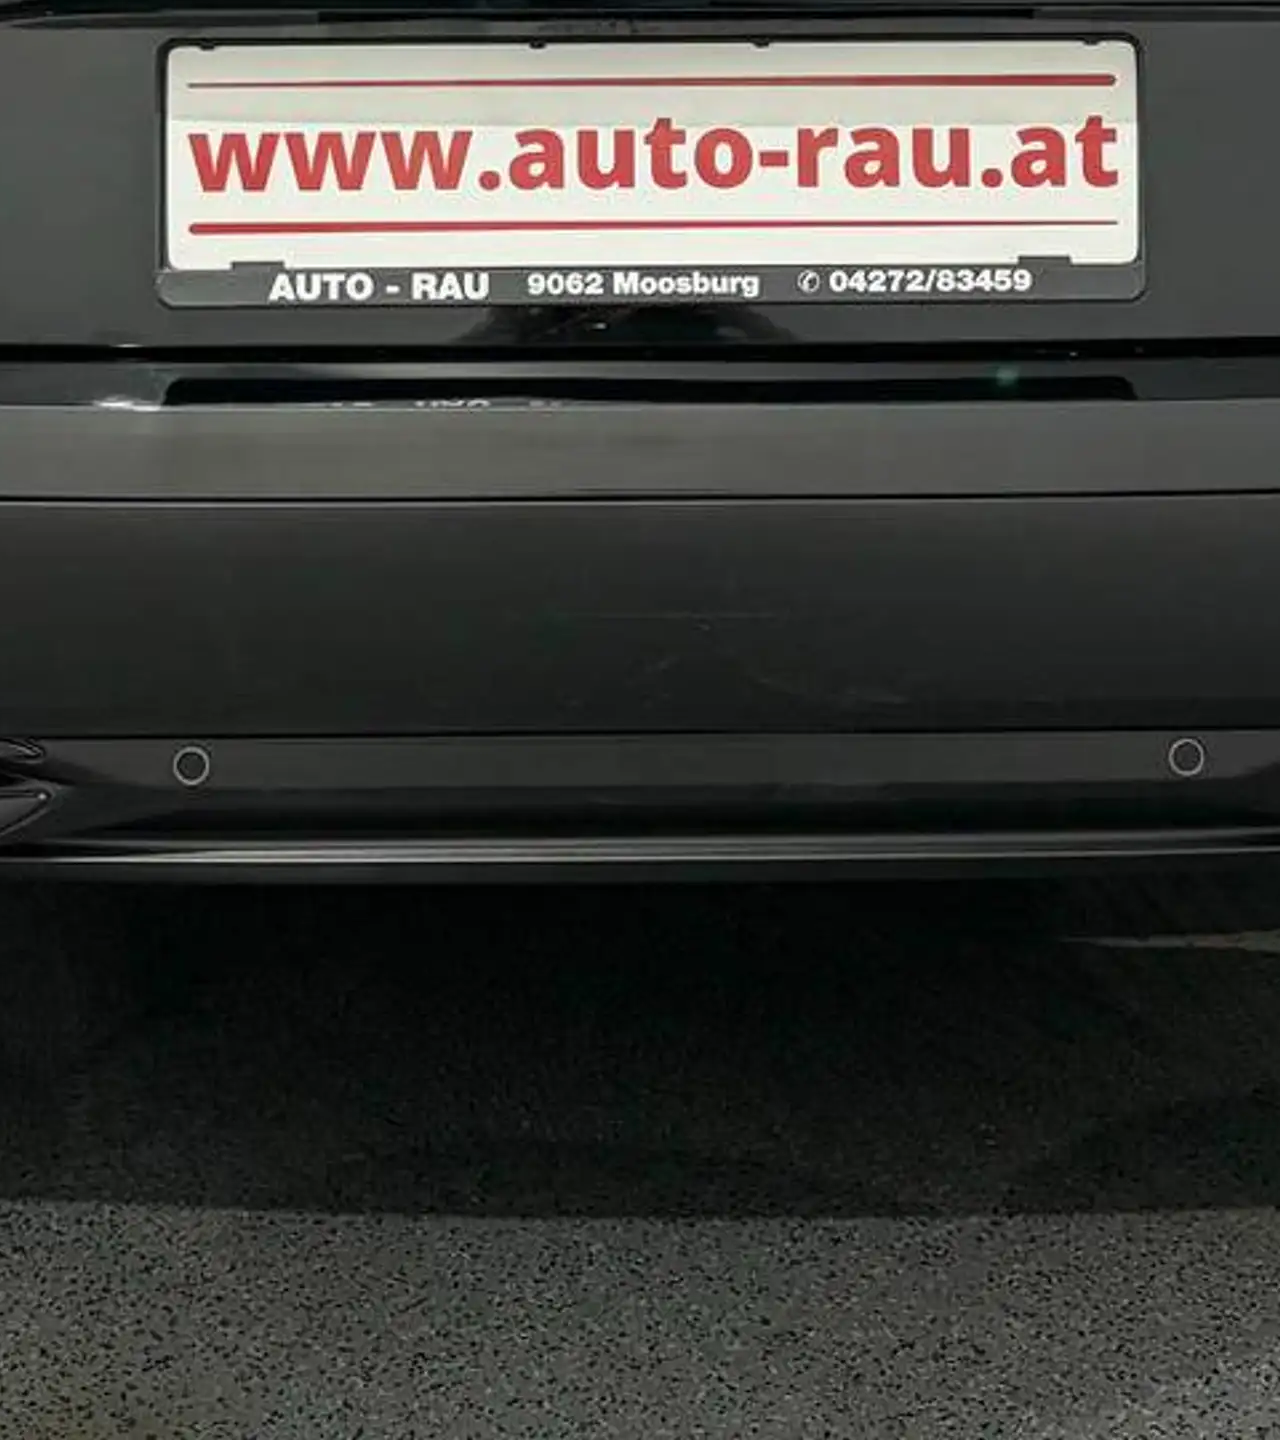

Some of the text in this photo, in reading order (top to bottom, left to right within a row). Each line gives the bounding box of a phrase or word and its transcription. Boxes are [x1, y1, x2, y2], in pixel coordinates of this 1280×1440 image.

[188, 115, 1119, 192] www.auto-rau.at
[268, 272, 374, 301] AUTO
[411, 272, 490, 300] RAU
[526, 271, 604, 296] 9062
[612, 269, 760, 297] Moosburg
[828, 268, 1032, 293] 04272/83459
